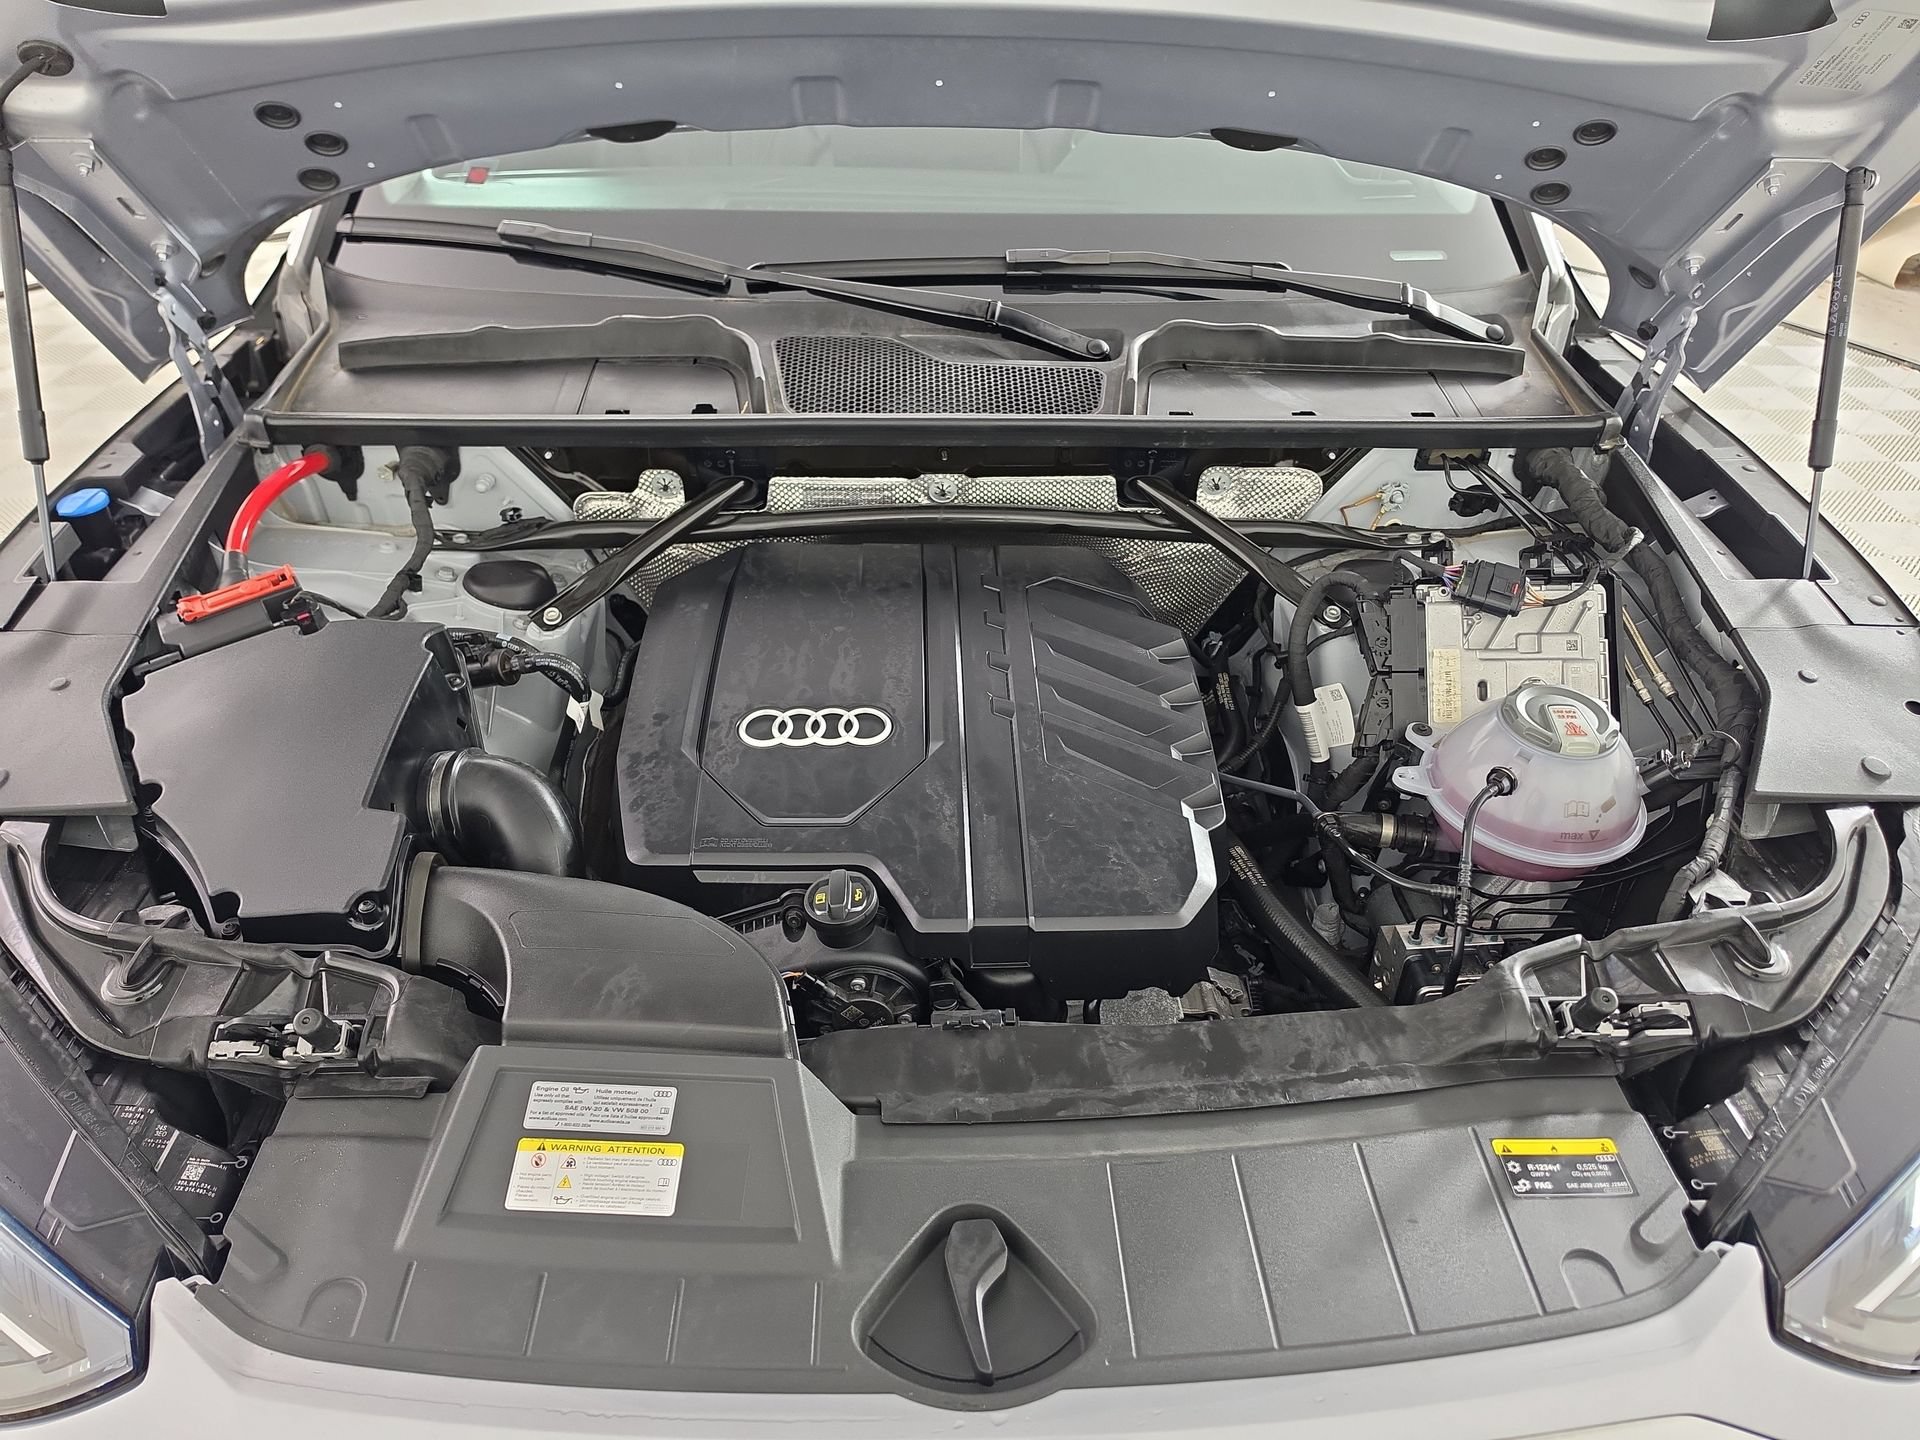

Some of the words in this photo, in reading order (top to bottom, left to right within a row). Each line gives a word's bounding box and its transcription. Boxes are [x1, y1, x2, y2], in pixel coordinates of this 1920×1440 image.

[1560, 832, 1584, 840] max
[551, 1144, 602, 1153] WARNING
[607, 1145, 666, 1155] ATTENTION
[1534, 1182, 1554, 1190] PAG
